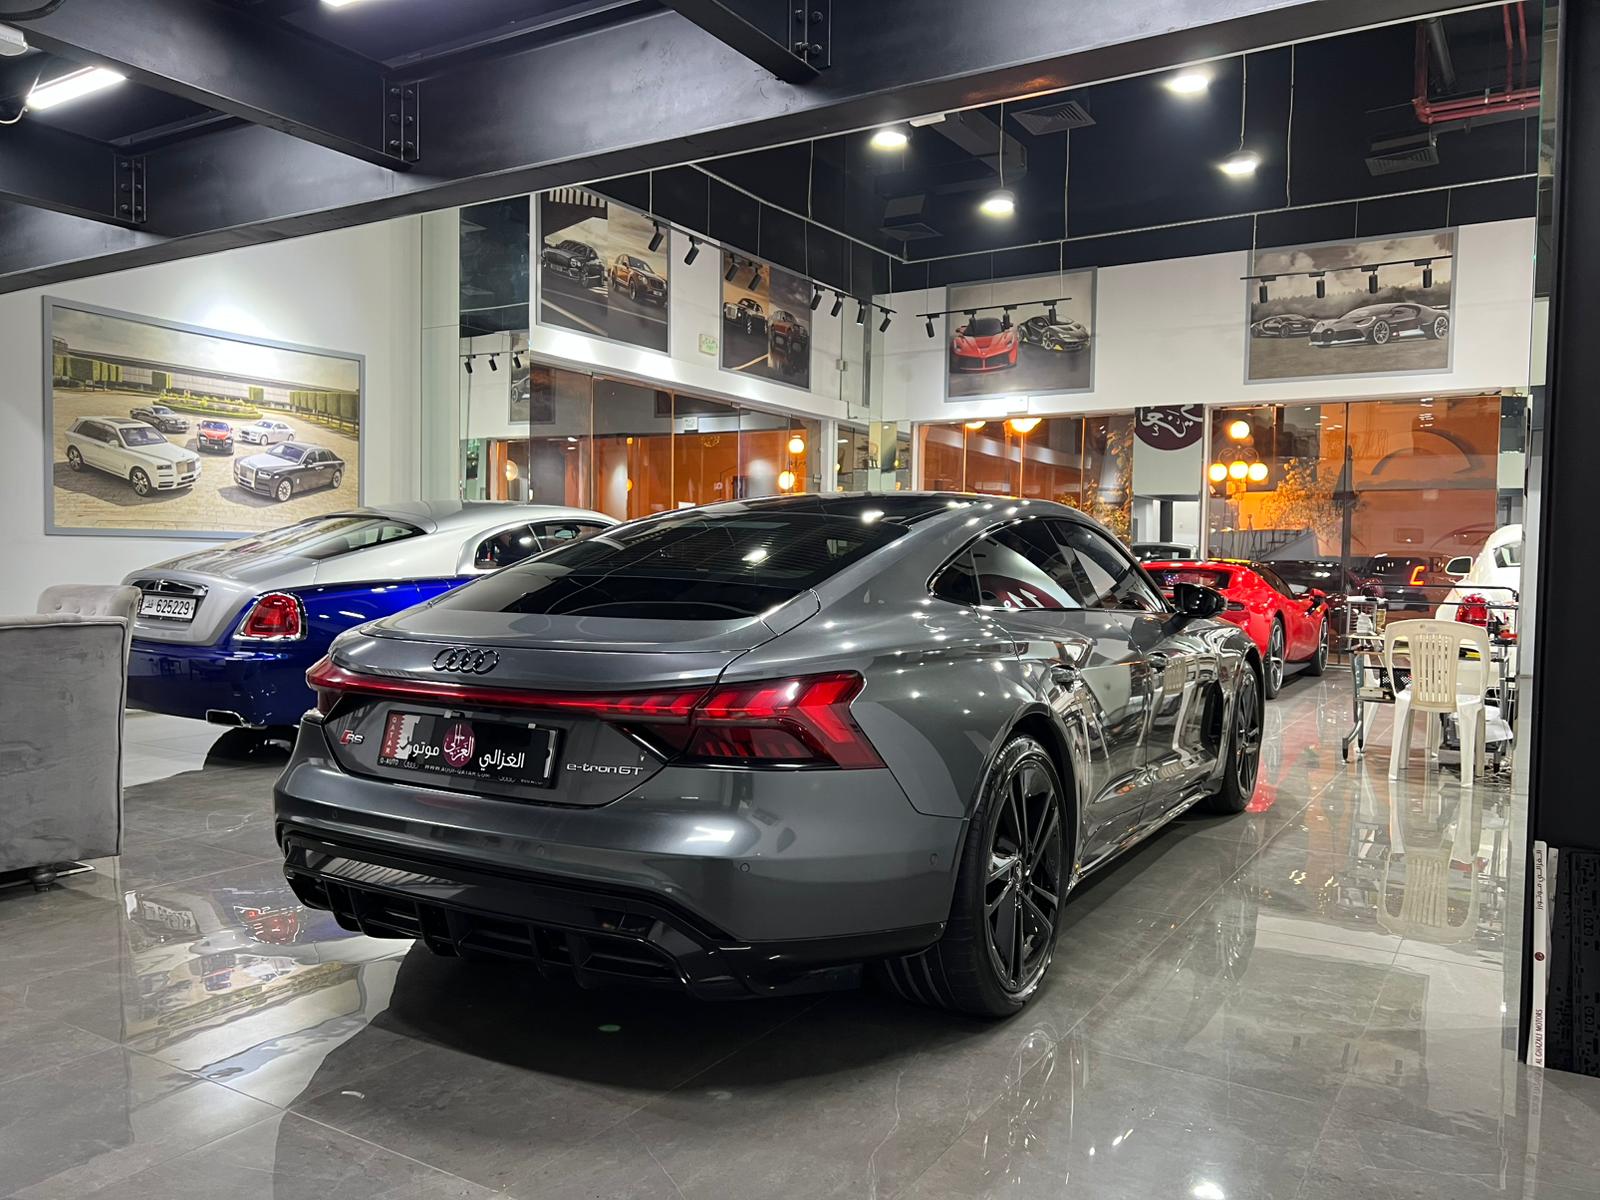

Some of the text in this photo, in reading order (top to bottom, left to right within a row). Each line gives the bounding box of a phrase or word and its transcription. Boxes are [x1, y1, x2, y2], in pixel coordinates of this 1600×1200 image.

[156, 599, 190, 615] 625229
[339, 729, 364, 745] RS
[384, 716, 398, 754] QATAR
[479, 748, 525, 771] الغزالي
[566, 763, 644, 776] e-tron GT
[1535, 1009, 1543, 1031] MOTORS
